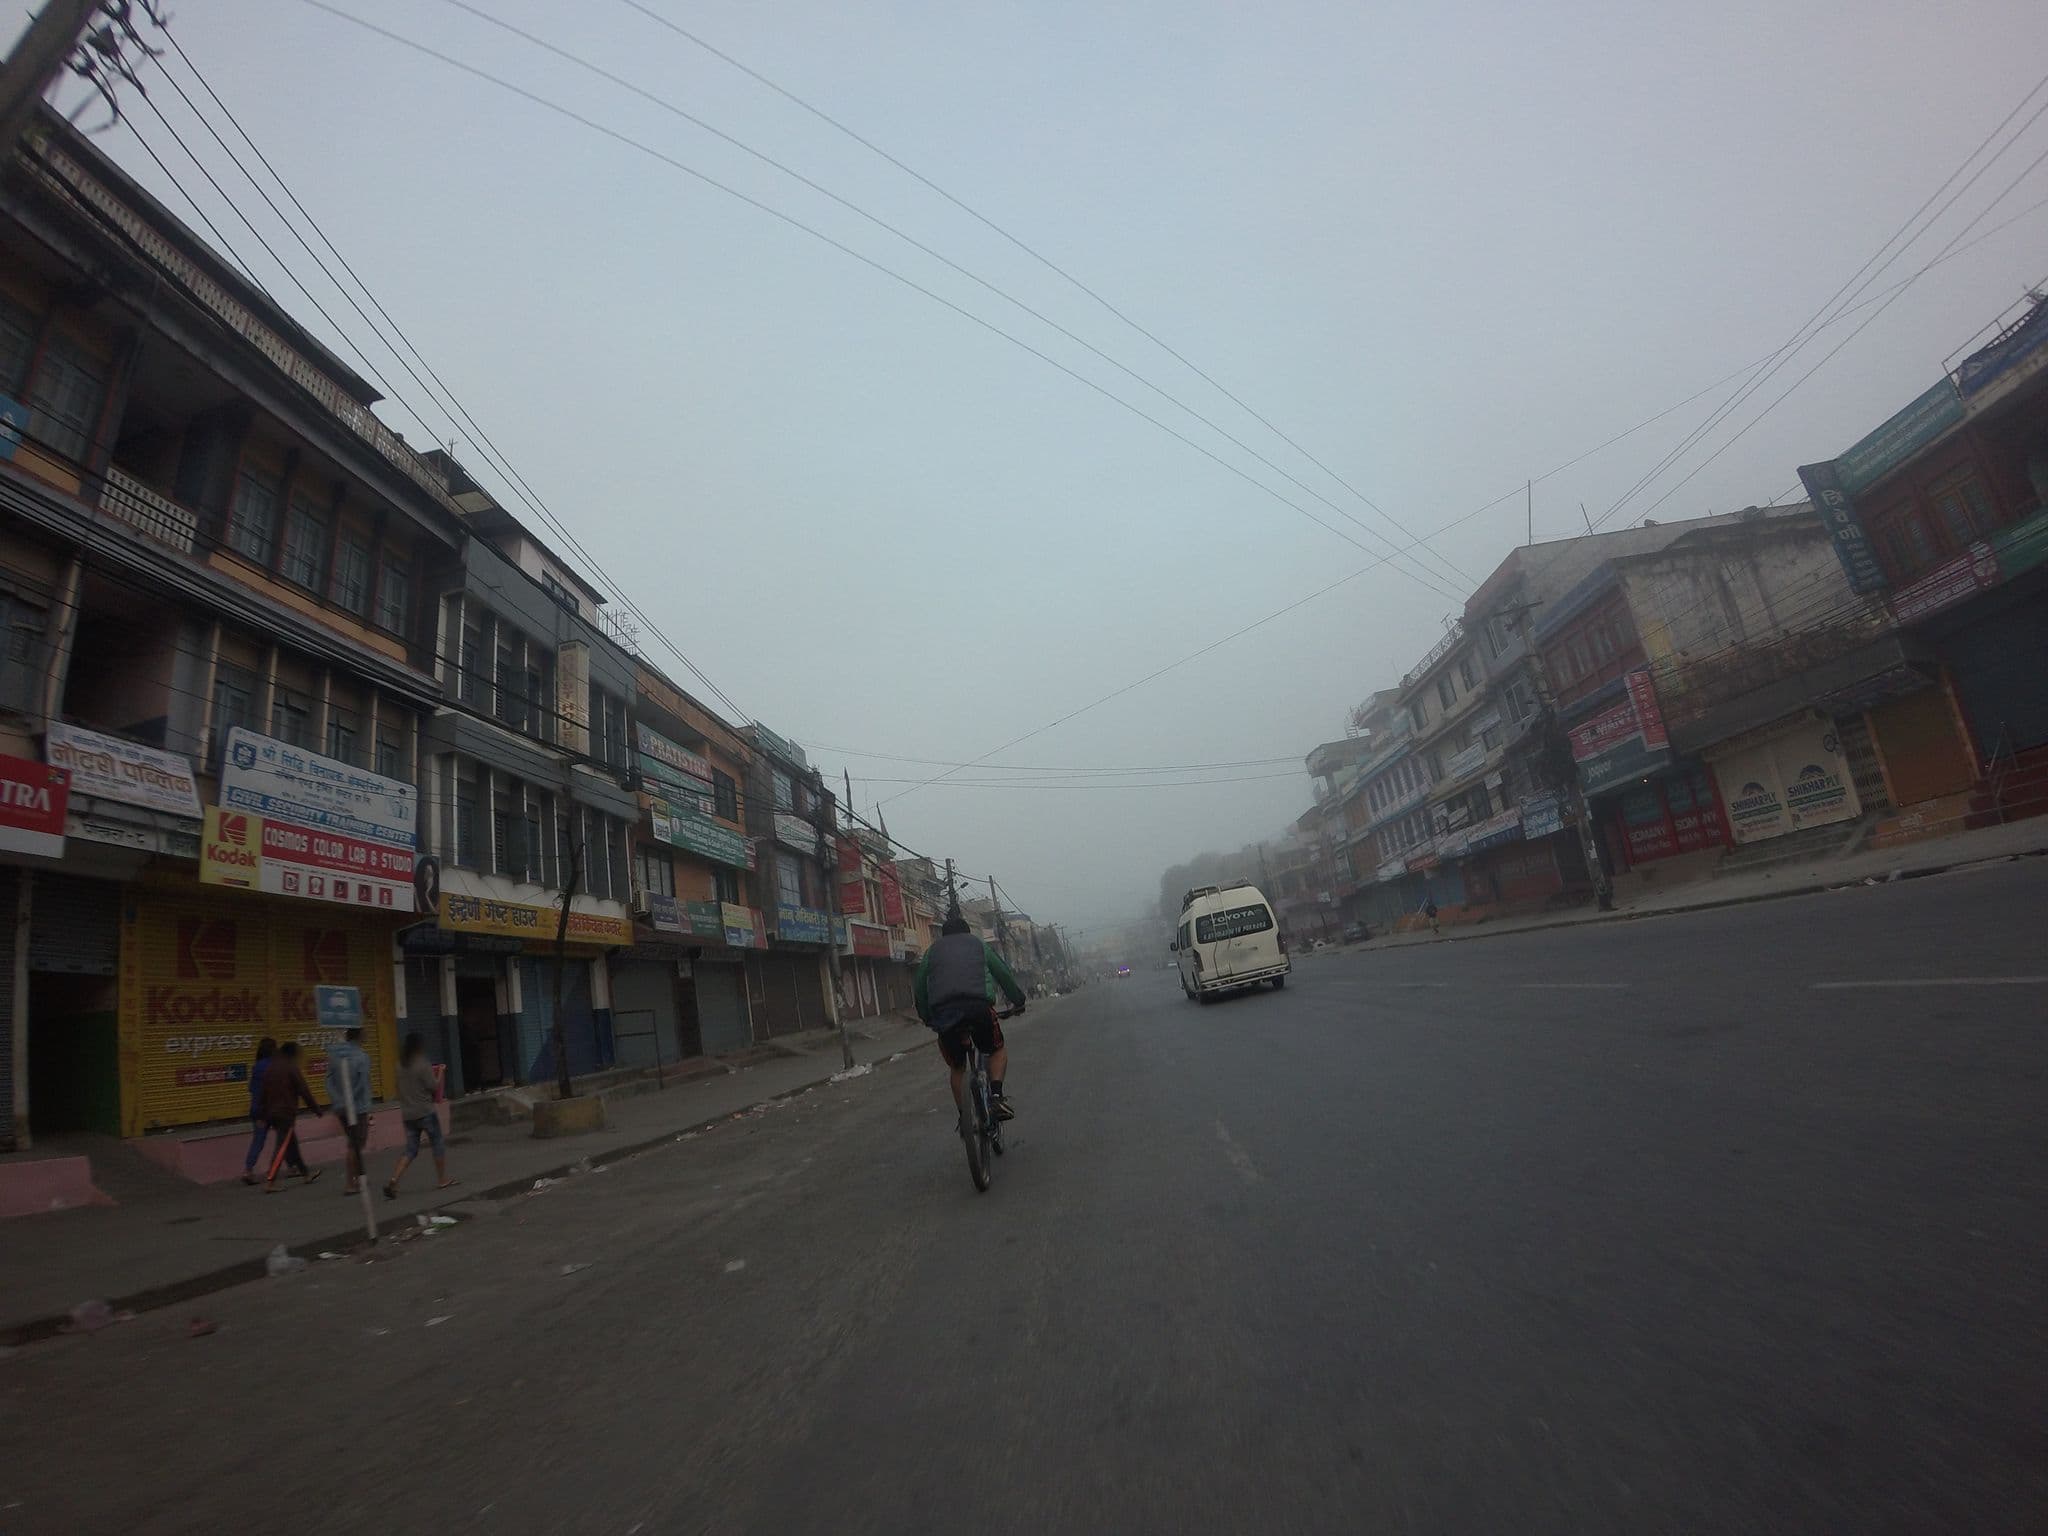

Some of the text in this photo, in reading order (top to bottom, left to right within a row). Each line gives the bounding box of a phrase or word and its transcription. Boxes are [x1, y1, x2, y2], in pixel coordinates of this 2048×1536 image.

[268, 797, 319, 820] SECURITY
[325, 811, 376, 834] TRAINING
[376, 825, 413, 843] CENTER
[207, 843, 257, 868] Kodak
[264, 827, 309, 853] COSMOS
[313, 838, 345, 858] COLOR
[348, 846, 367, 864] LAB
[381, 852, 412, 873] STUDIO
[1209, 911, 1256, 923] TOYOTA
[146, 984, 264, 1025] Kodak
[165, 1031, 253, 1058] express
